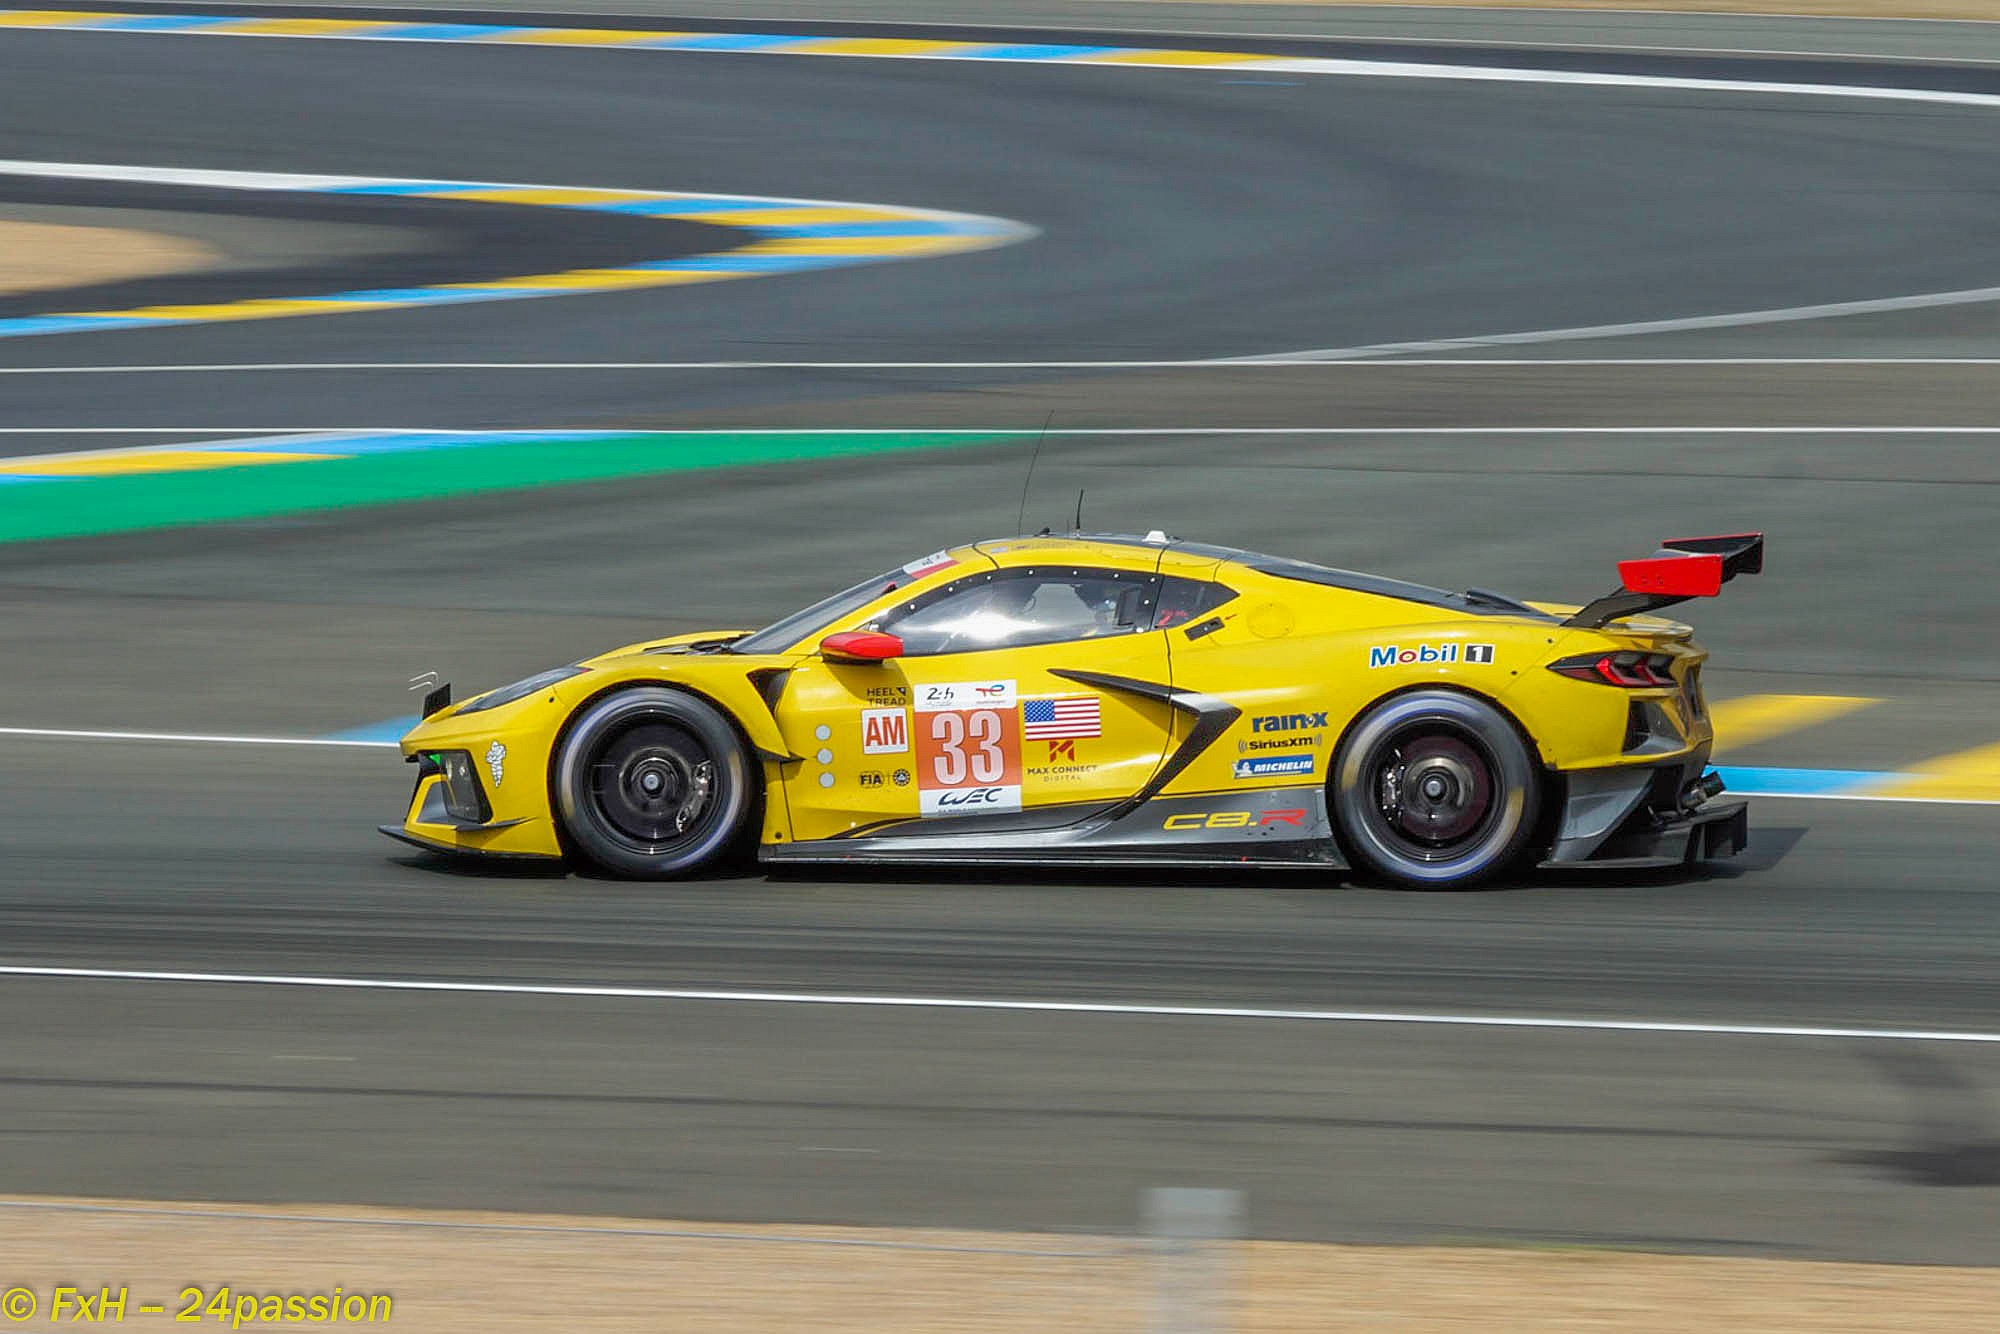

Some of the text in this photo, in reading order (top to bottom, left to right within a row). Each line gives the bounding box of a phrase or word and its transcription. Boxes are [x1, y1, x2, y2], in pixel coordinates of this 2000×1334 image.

[1371, 644, 1457, 667] Mobil
[867, 687, 895, 696] HEEL
[867, 697, 906, 706] TREAD
[866, 716, 905, 747] AM
[932, 710, 1005, 785] 33
[1027, 765, 1097, 775] MAX CONNECT
[1253, 760, 1313, 773] MICHELIN
[860, 774, 883, 786] FIA
[938, 788, 1003, 806] WEC
